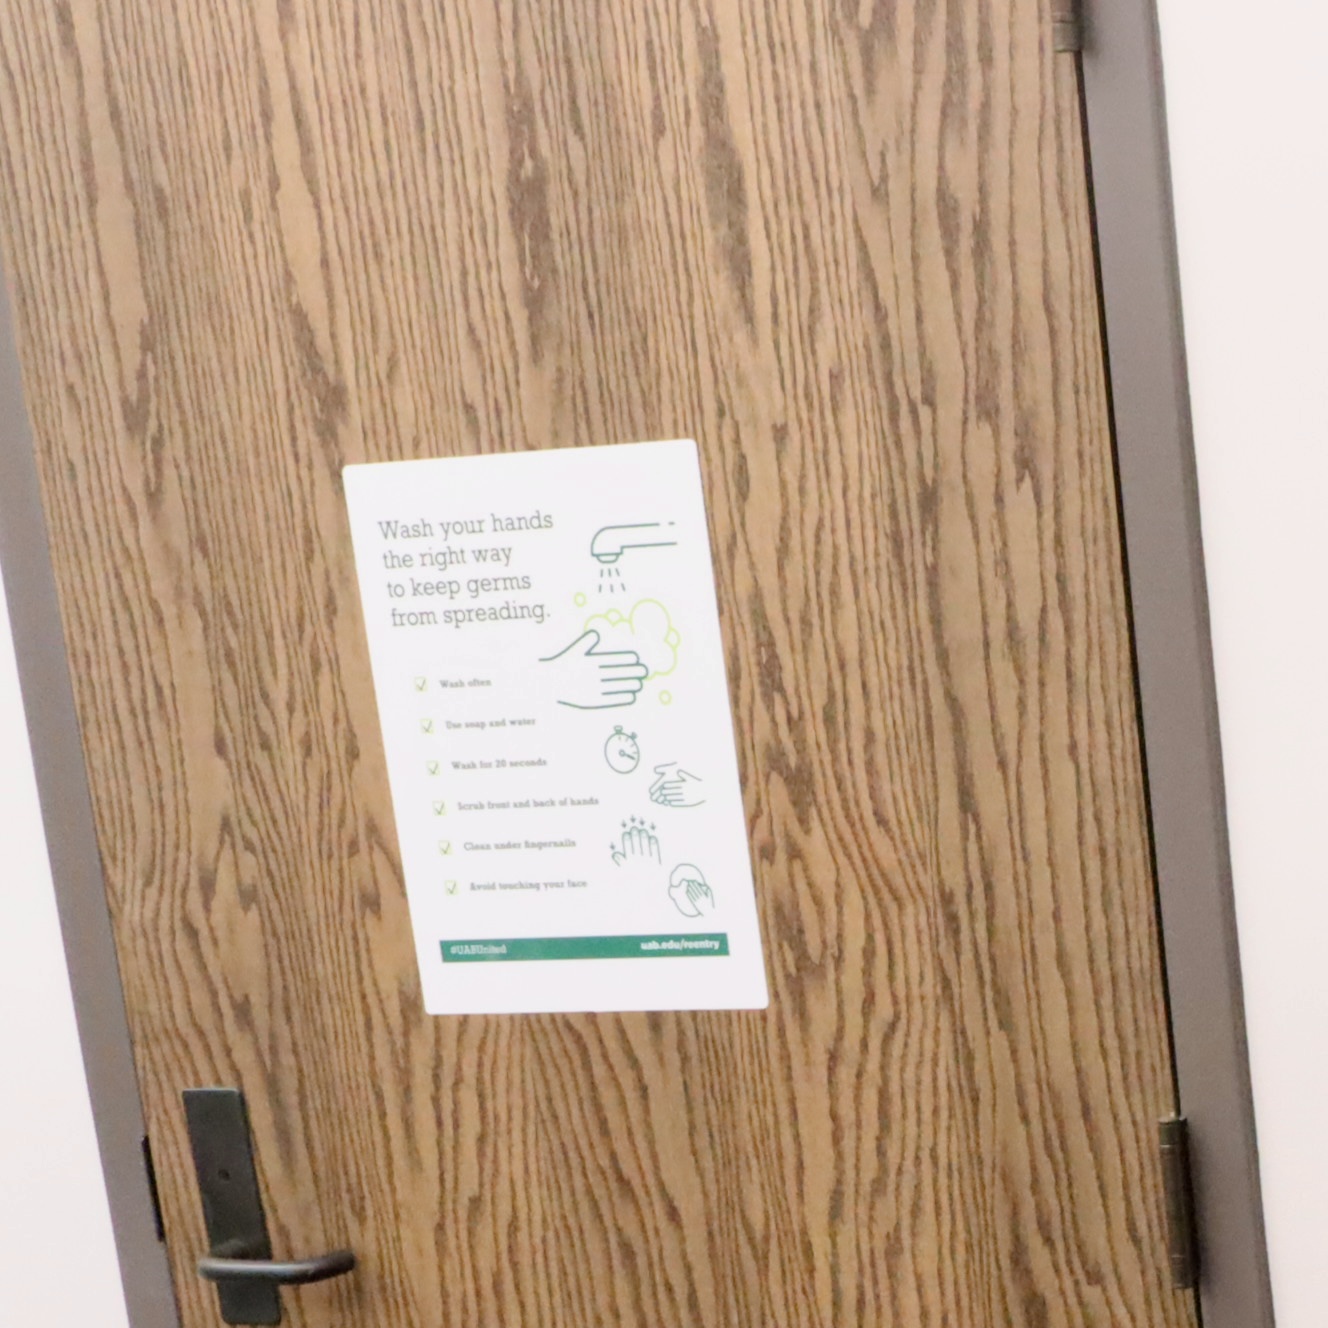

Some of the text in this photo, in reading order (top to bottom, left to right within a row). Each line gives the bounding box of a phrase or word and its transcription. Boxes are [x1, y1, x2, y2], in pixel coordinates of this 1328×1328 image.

[378, 510, 554, 541] Wash your hands
[382, 546, 513, 571] the right way
[386, 575, 532, 600] to keep germs
[391, 601, 551, 629] from spreading.
[439, 678, 492, 689] Wash often
[465, 720, 486, 730] soap
[489, 718, 507, 728] and
[509, 718, 536, 727] water
[451, 761, 477, 770] Wash
[495, 759, 507, 768] 20
[509, 757, 547, 767] seconds
[513, 799, 530, 809] and
[533, 798, 556, 808] back
[570, 796, 600, 806] hands
[463, 838, 577, 851] Clean under fingernails
[498, 881, 541, 891] touching
[543, 881, 564, 890] your
[567, 879, 588, 888] face
[640, 937, 720, 951] uab.edu/reentry
